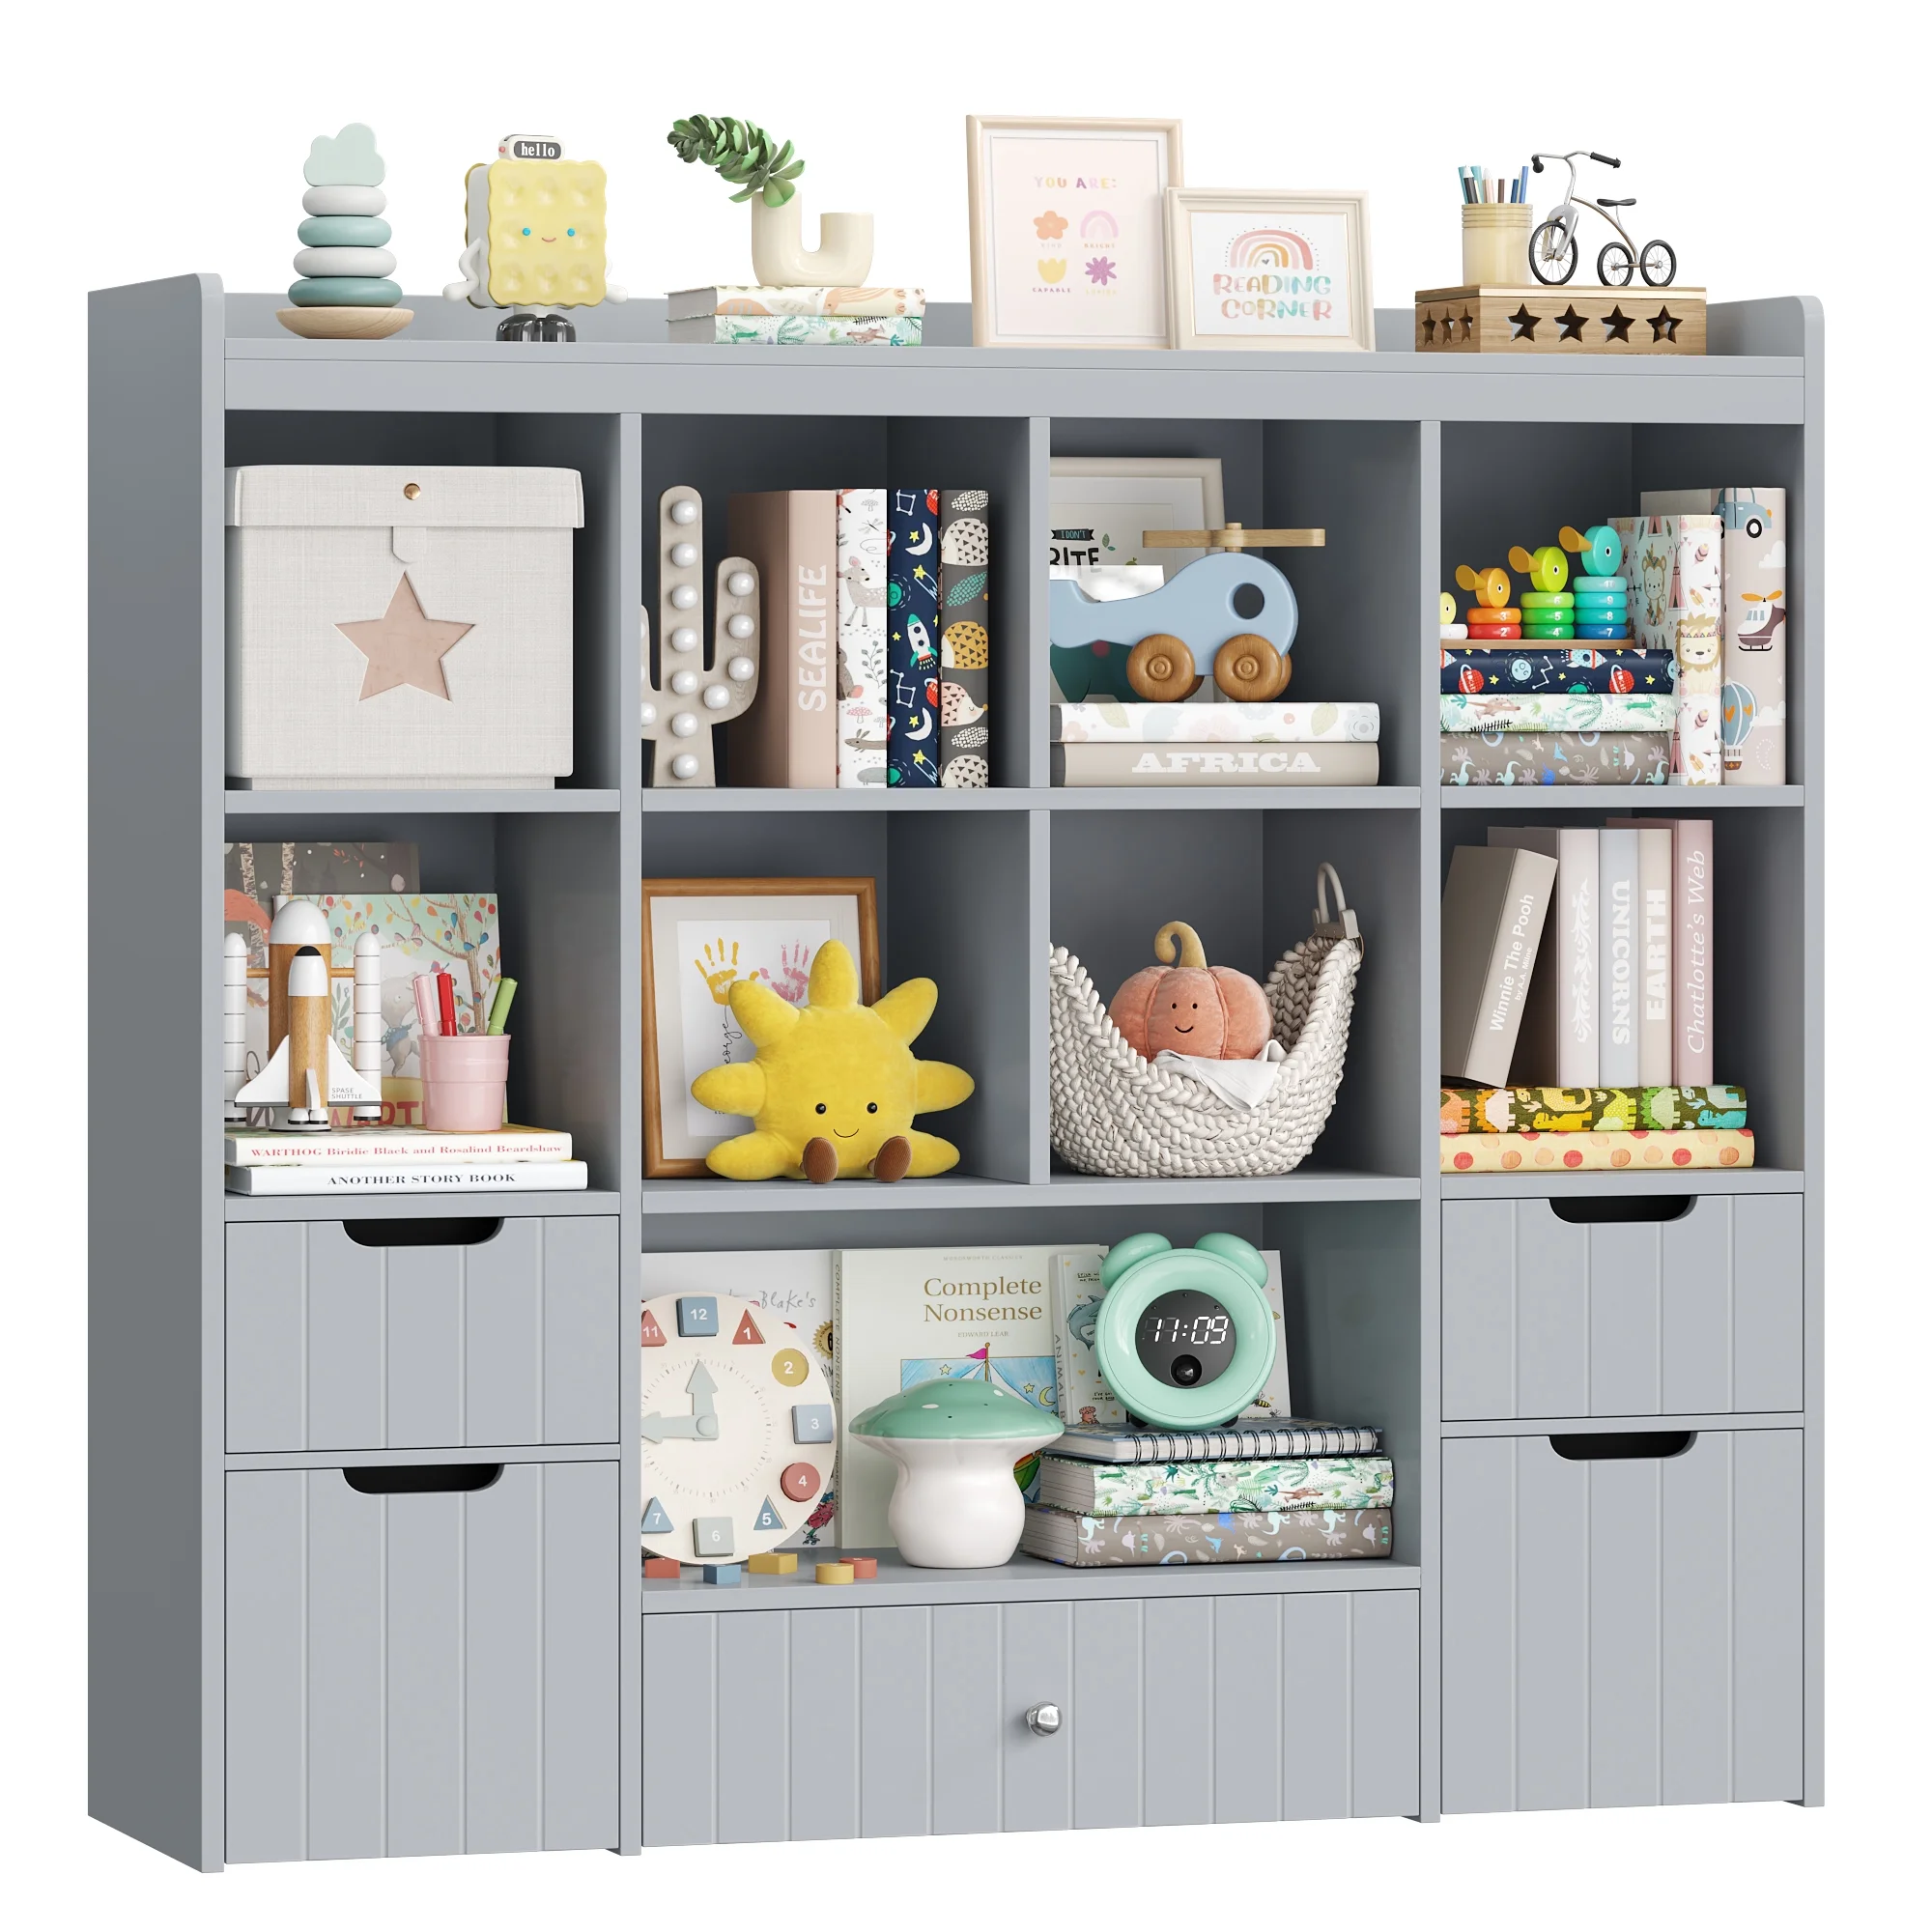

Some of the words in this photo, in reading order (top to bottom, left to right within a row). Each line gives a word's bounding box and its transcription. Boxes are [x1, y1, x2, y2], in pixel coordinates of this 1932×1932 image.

[521, 142, 555, 157] hello
[1034, 177, 1067, 188] YOU
[1212, 272, 1331, 296] READING
[1220, 298, 1333, 321] CORNER
[1061, 530, 1065, 539] I
[1065, 530, 1086, 539] DON'T
[797, 563, 828, 713] SEALIFE
[1500, 627, 1508, 638] 2
[1552, 627, 1560, 638] 4
[1606, 627, 1614, 638] 7
[1131, 752, 1321, 773] AFRICA
[1687, 849, 1706, 906] Web
[1512, 894, 1535, 938] Pooh
[1503, 940, 1523, 972] The
[1611, 878, 1631, 1046] UNICORNS
[1645, 888, 1667, 1021] EARTH
[1514, 990, 1524, 1002] by
[1521, 947, 1533, 970] Milne
[1489, 975, 1516, 1032] Winnie
[251, 1148, 322, 1156] WARTHOG
[374, 1147, 409, 1155] Black
[412, 1146, 435, 1154] and
[440, 1145, 492, 1154] Rosalind
[327, 1176, 406, 1185] ANOTHER
[411, 1175, 464, 1183] STORY
[469, 1174, 517, 1182] BOOK
[923, 1275, 1042, 1300] Complete
[758, 1289, 816, 1313] Blake's
[690, 1308, 708, 1321] 12
[923, 1303, 1042, 1322] Nonsense
[642, 1325, 659, 1338] 11
[743, 1326, 752, 1340] 1
[1154, 1315, 1229, 1344] 11:09
[783, 1360, 794, 1375] 2
[810, 1418, 820, 1430] 3
[798, 1475, 808, 1487] 4
[652, 1513, 662, 1525] 7
[762, 1512, 772, 1525] 5
[711, 1530, 721, 1542] 6
